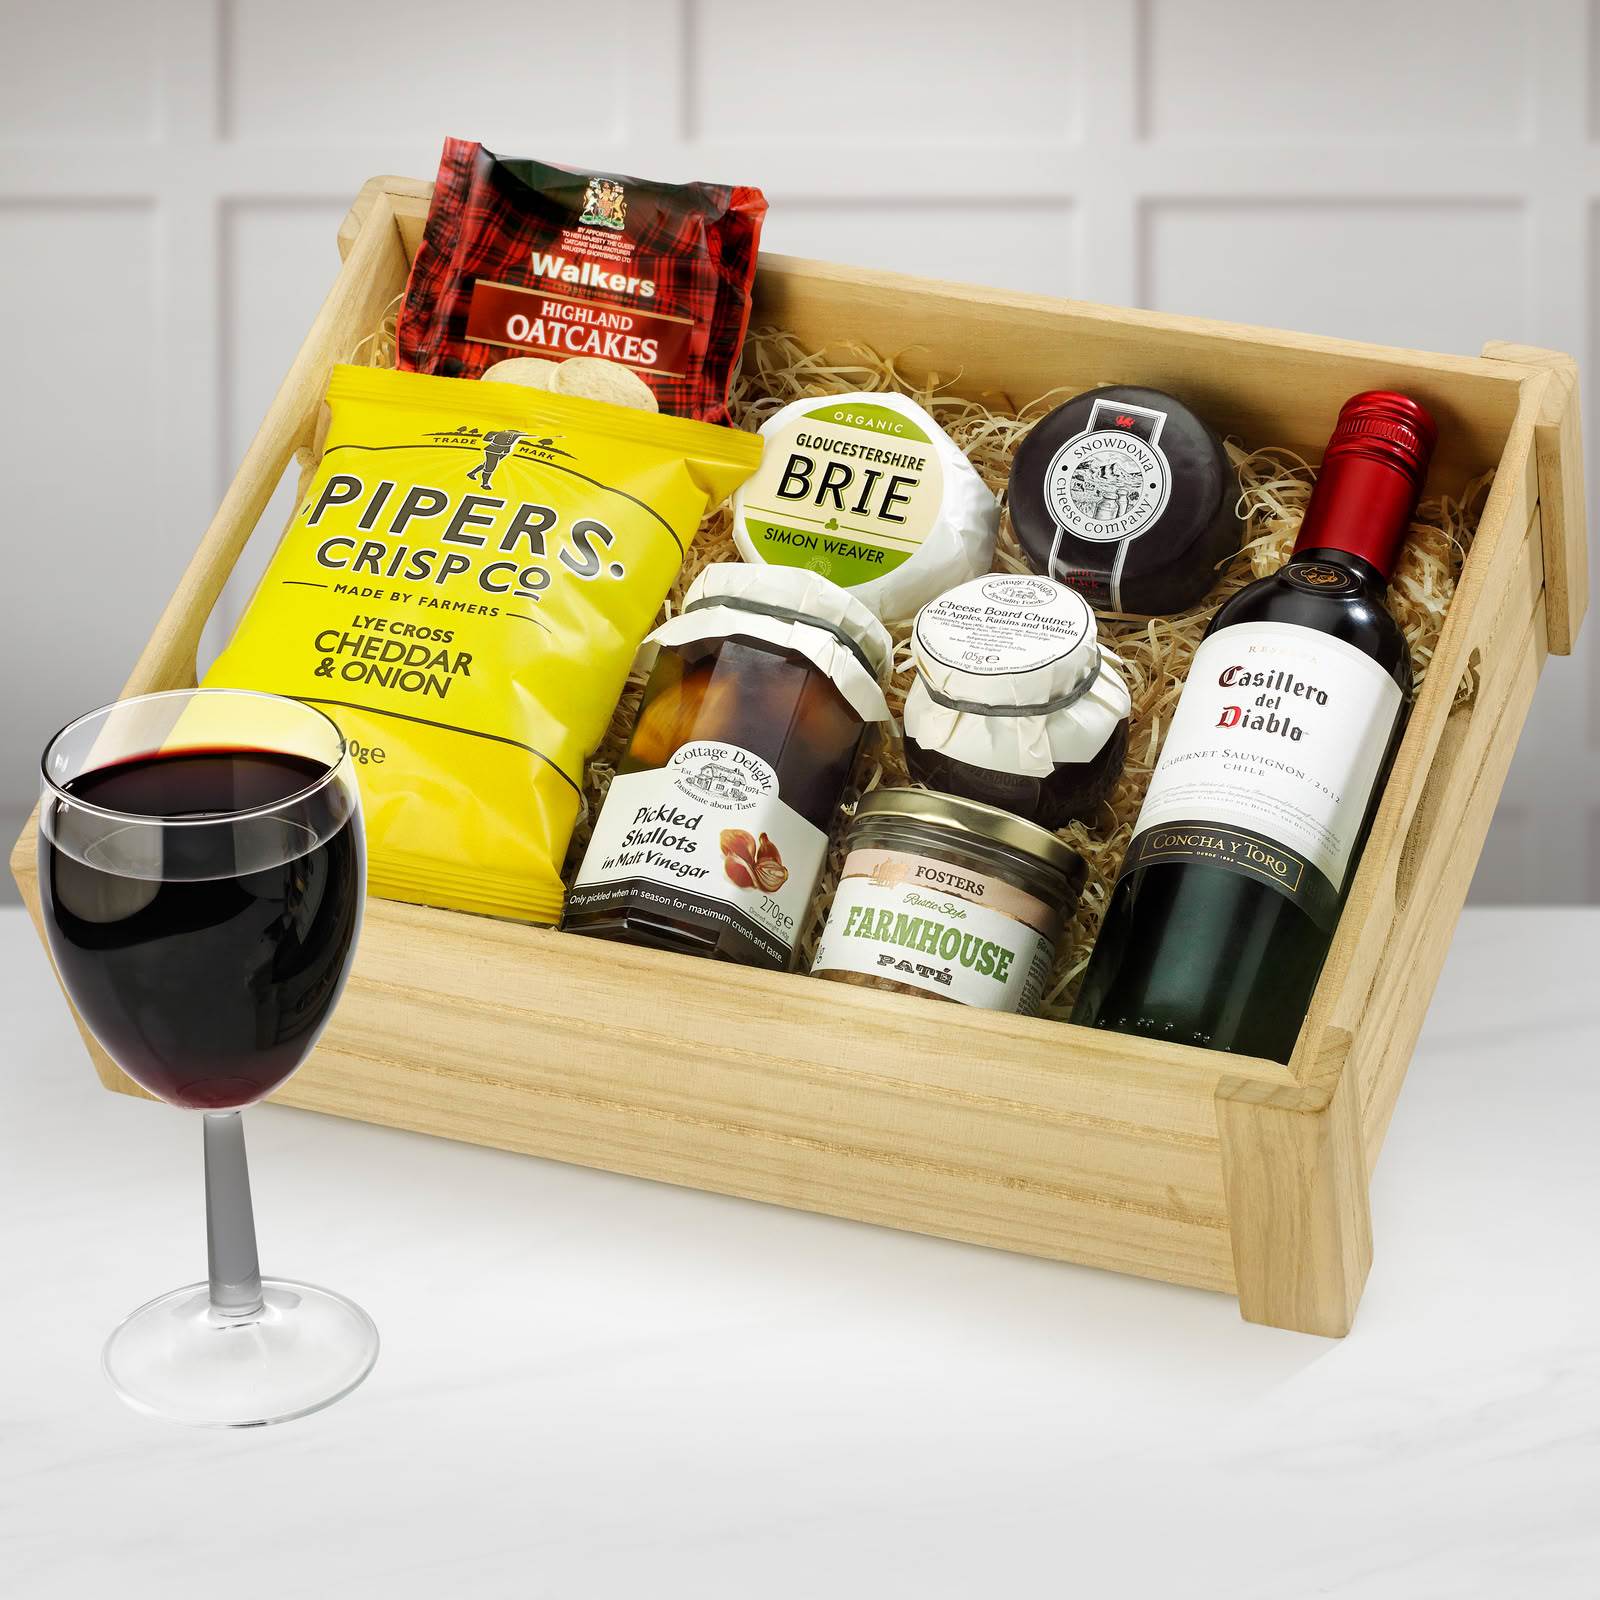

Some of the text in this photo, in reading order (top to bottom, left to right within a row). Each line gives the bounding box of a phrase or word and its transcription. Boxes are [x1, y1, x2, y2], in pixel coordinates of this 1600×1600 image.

[531, 252, 655, 297] Walkers
[541, 301, 633, 330] HIGHLAND
[506, 314, 658, 364] OATCAKES
[834, 411, 904, 433] ORGANIC
[433, 437, 556, 461] TRADE MARK
[796, 433, 926, 472] GLOUCESTERSHIRE
[775, 453, 920, 524] BRIE
[316, 537, 471, 585] CRISP
[764, 528, 885, 564] SIMON WEAVER
[334, 584, 500, 617] MADE BY FARMERS
[938, 600, 982, 614] Cheese
[984, 606, 1022, 619] Board
[1024, 611, 1076, 628] Chutney
[352, 615, 454, 643] LYE CROSS
[927, 608, 947, 617] with
[948, 611, 983, 623] Apples,
[985, 616, 1020, 626] Raisins
[1020, 621, 1040, 630] and
[1042, 624, 1078, 637] Walnuts
[314, 629, 473, 677] CHEDDAR
[314, 657, 452, 699] & ONION
[1218, 665, 1329, 706] Casillero
[1255, 694, 1281, 710] del
[1215, 705, 1303, 742] Diablo
[674, 747, 772, 791] Cottage Delight
[680, 768, 693, 776] Est.
[1161, 750, 1218, 770] CABERNET
[1222, 749, 1305, 779] SAUVIGNON
[1315, 782, 1341, 804] 2012
[1223, 763, 1265, 776] CHILE
[674, 779, 757, 811] Passionate about Taste
[633, 803, 704, 831] Pickled
[621, 826, 698, 854] Shallots
[1153, 833, 1287, 876] CONCHA Y TORO
[601, 850, 710, 880] in Malt Vinegar
[915, 865, 985, 896] FOSTERS
[903, 892, 938, 910] Rustic
[569, 894, 587, 906] Only
[586, 891, 612, 905] pickled
[611, 889, 630, 899] when
[630, 887, 639, 896] in
[640, 890, 671, 905] season
[672, 898, 688, 910] for
[689, 905, 732, 925] maximum
[731, 920, 754, 941] crunch
[753, 937, 767, 950] and
[842, 905, 1016, 984] FARMHOUSE
[876, 953, 953, 986] PATÉ
